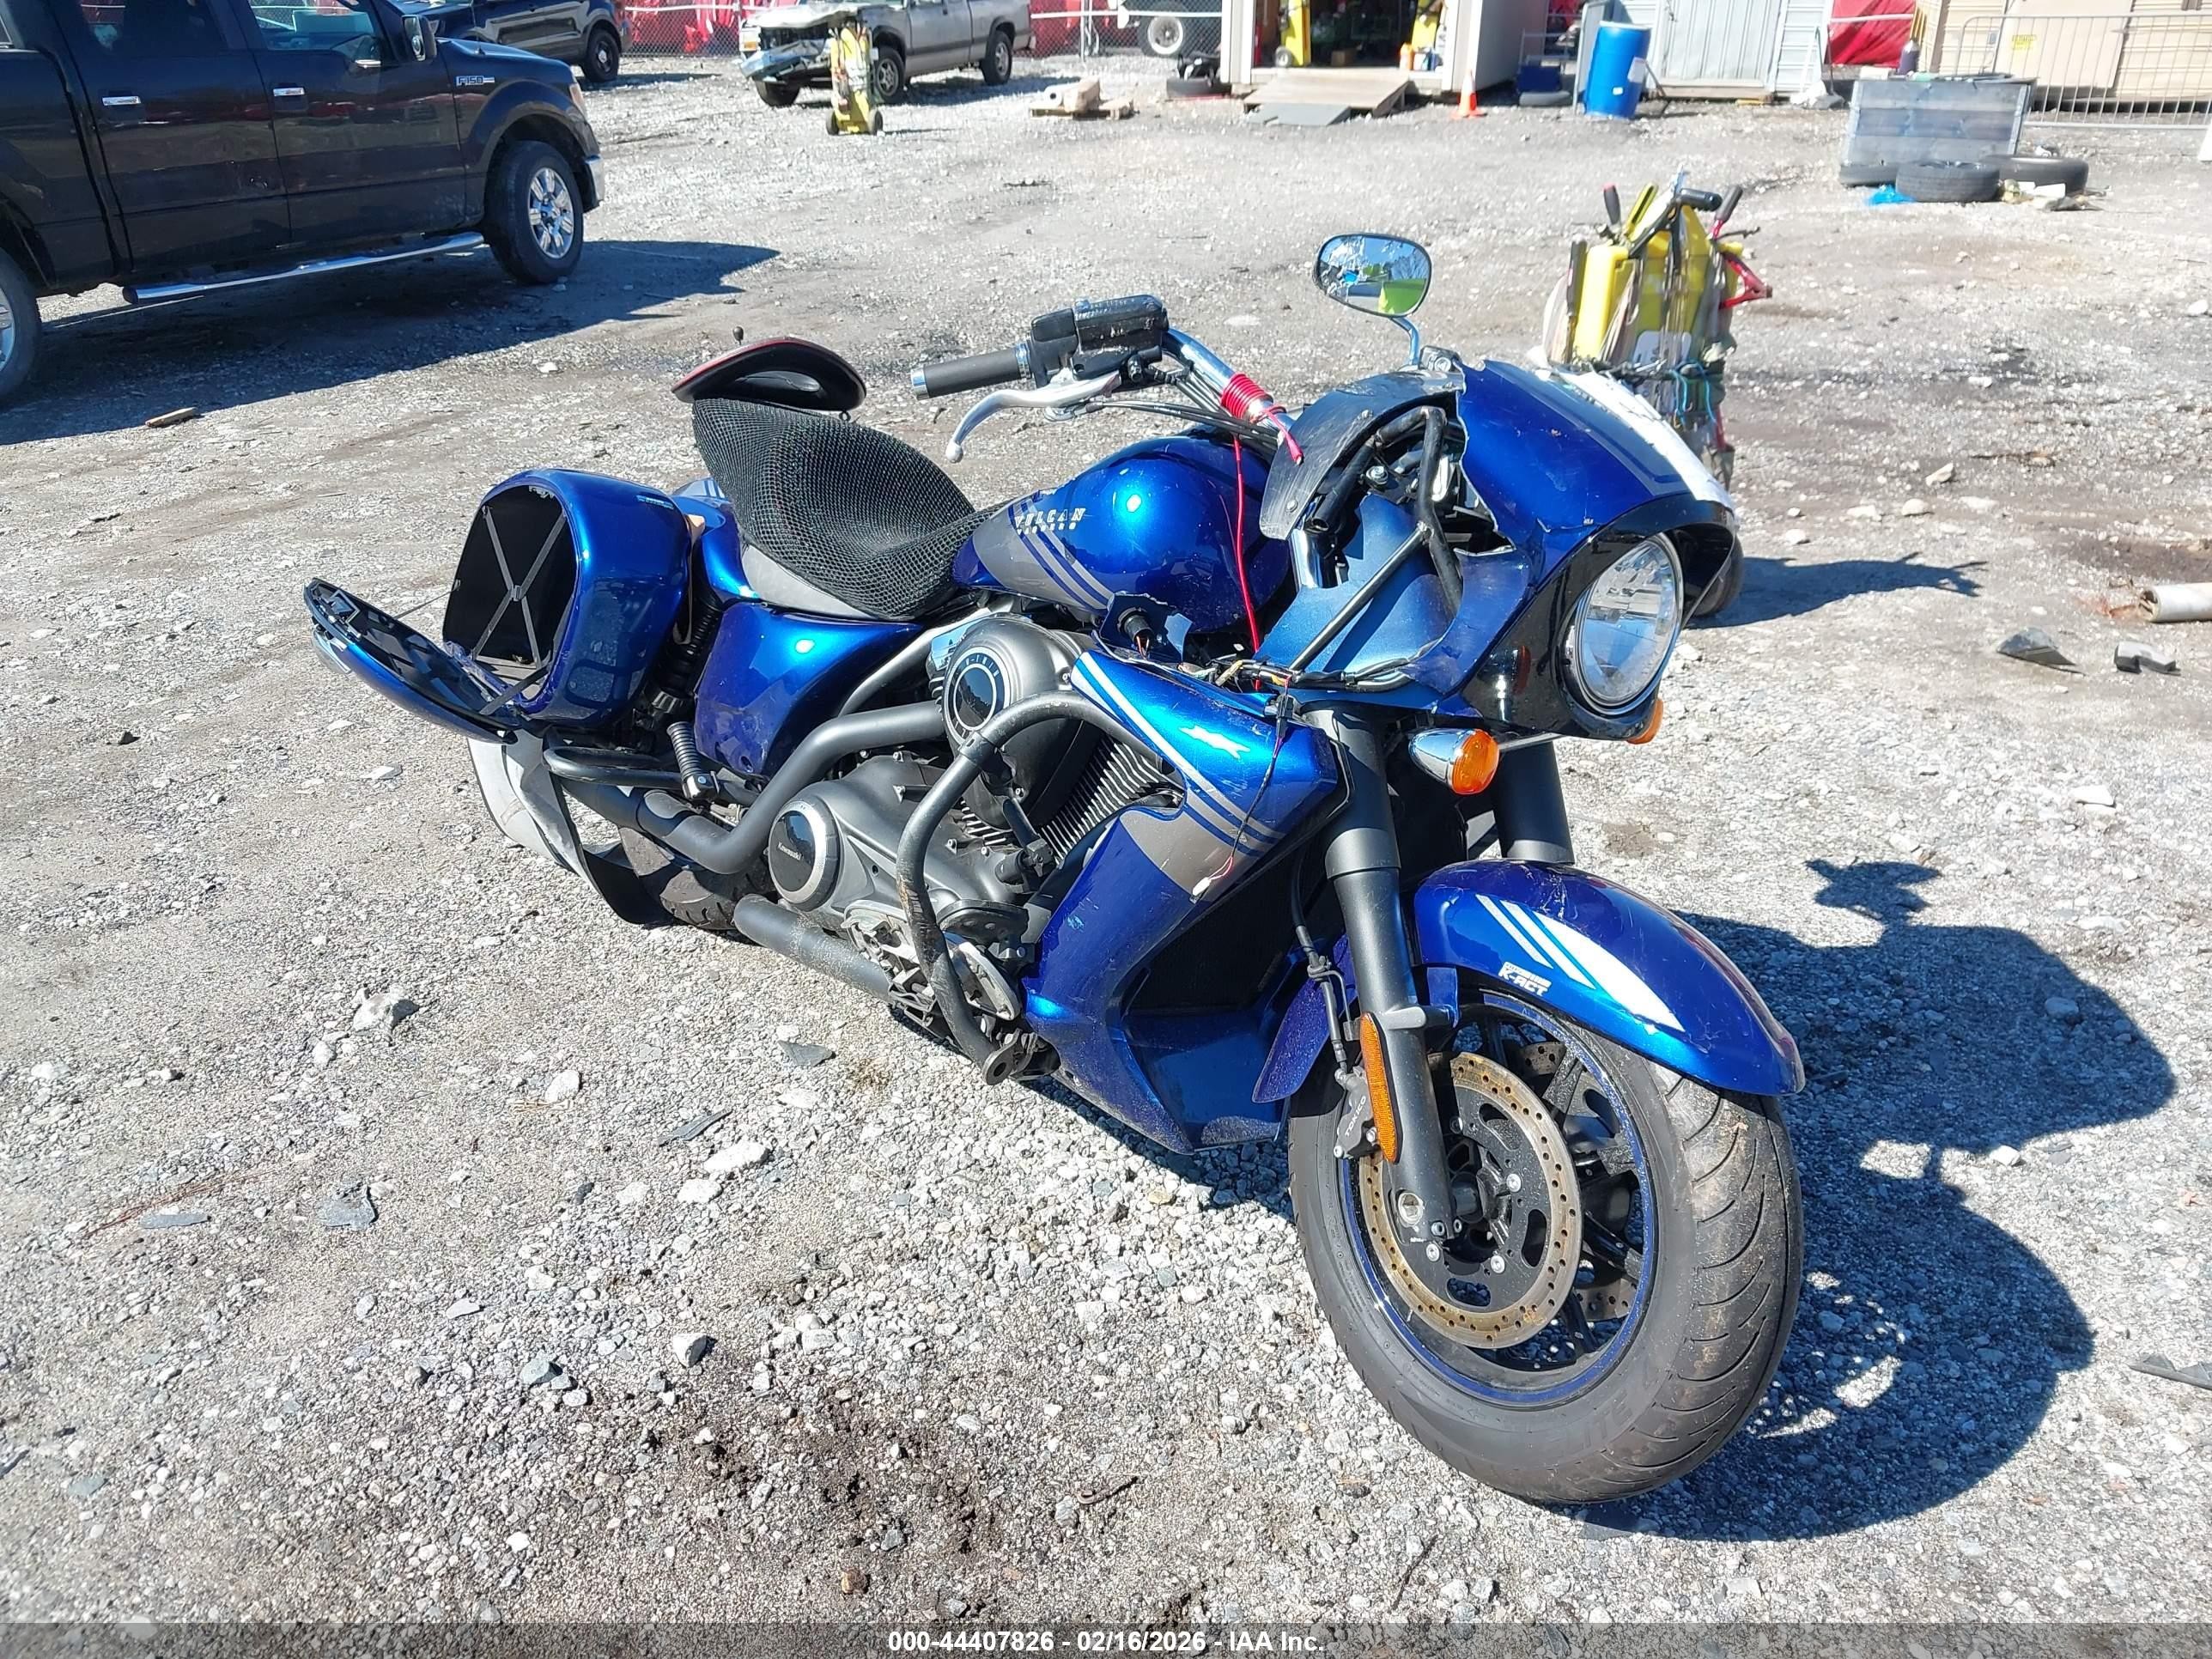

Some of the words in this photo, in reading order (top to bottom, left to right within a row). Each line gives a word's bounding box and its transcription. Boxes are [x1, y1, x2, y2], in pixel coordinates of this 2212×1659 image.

[1014, 507, 1086, 529] VULCAN
[777, 842, 802, 861] Kawasaki
[1498, 969, 1548, 997] K-ACT
[1345, 1095, 1367, 1137] TOKICO
